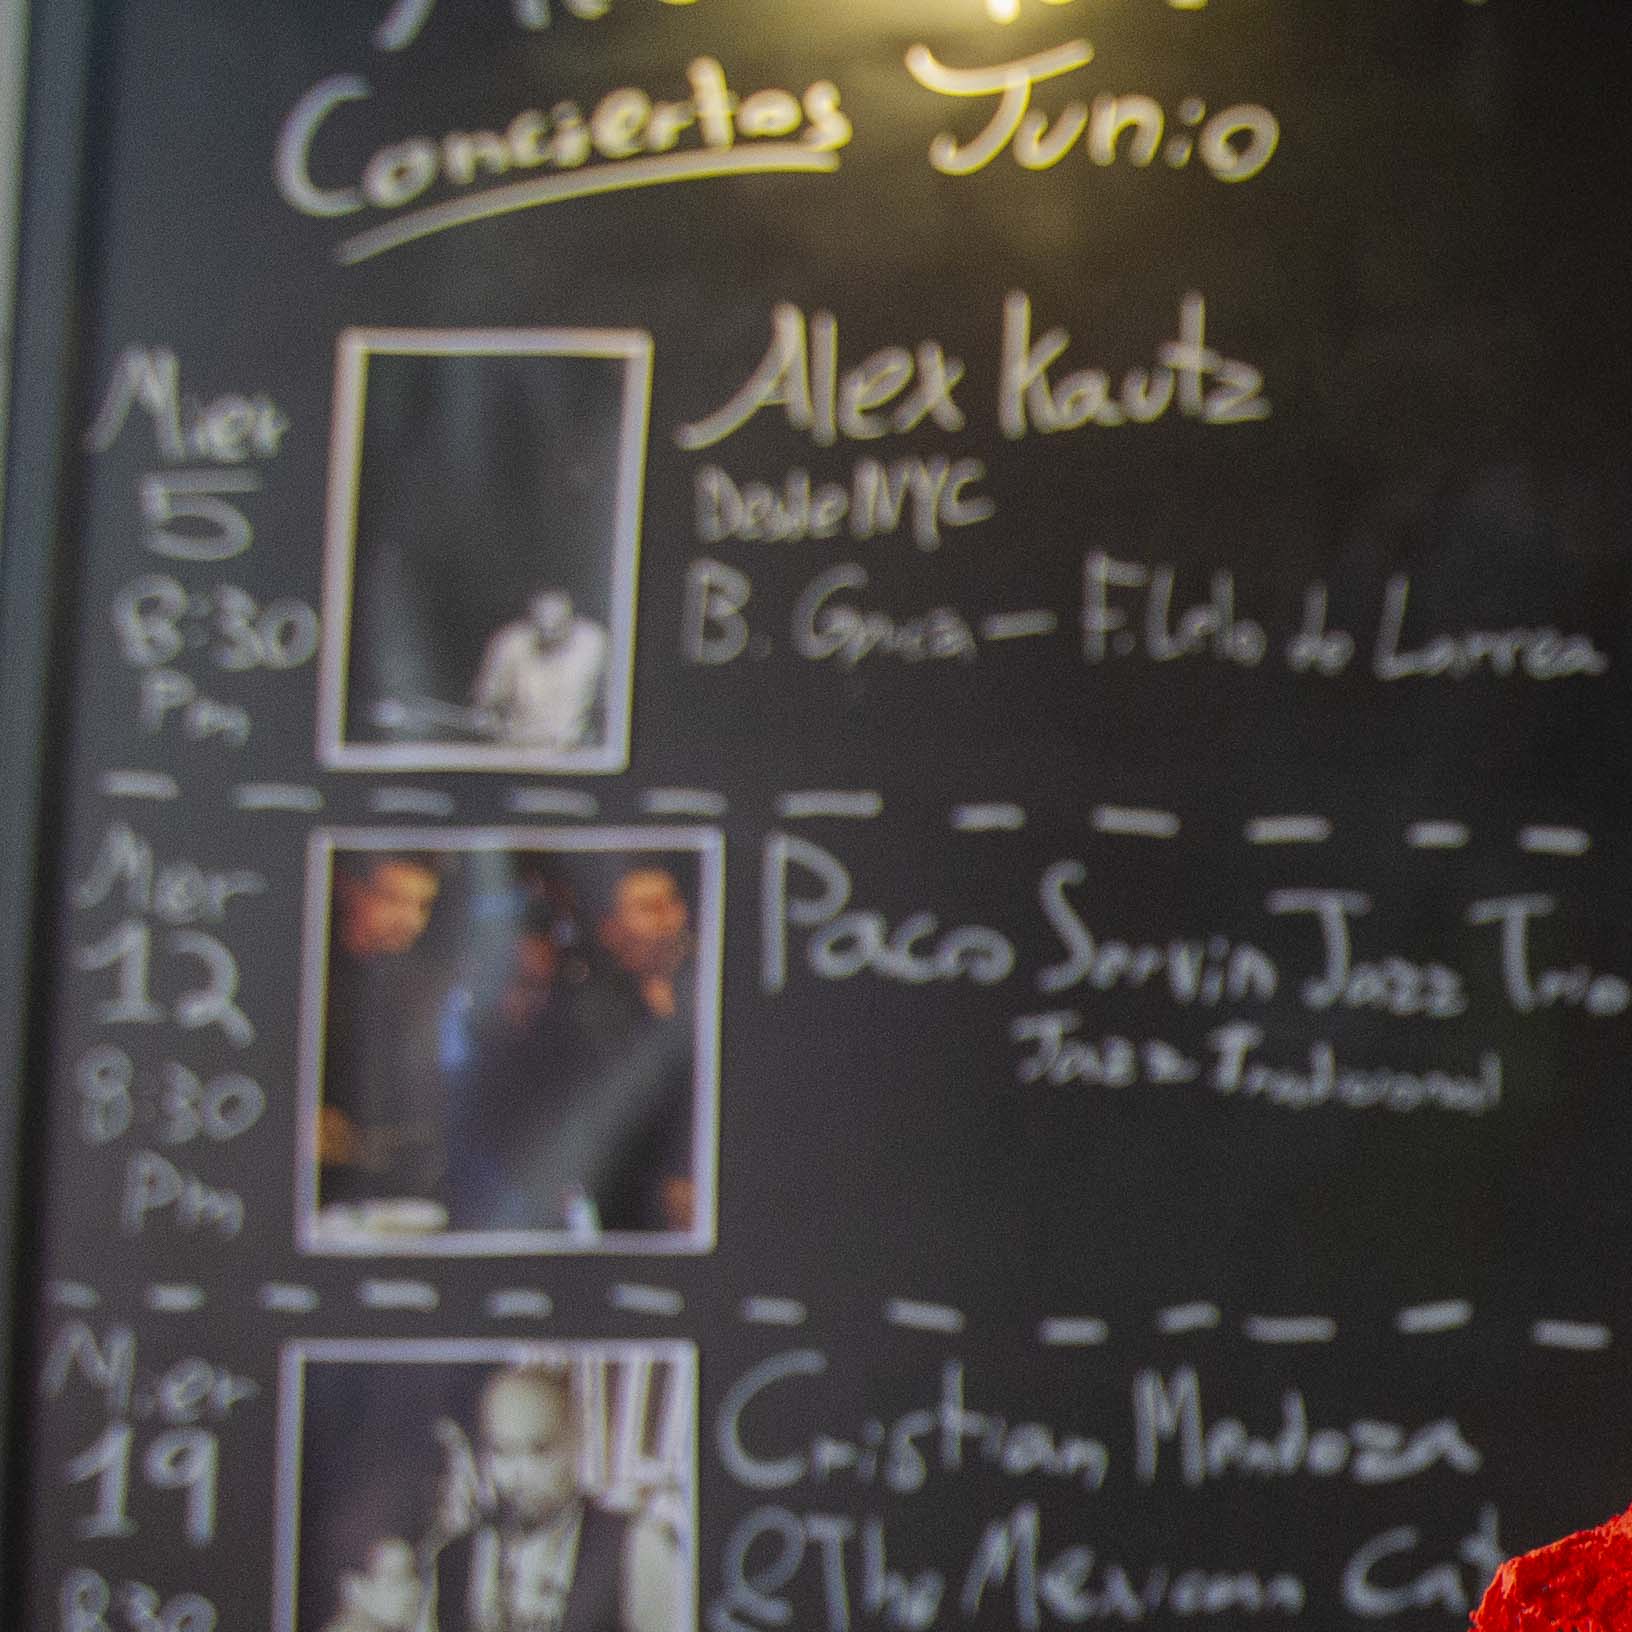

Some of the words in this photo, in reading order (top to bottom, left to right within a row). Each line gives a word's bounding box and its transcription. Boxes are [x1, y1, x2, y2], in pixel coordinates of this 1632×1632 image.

[276, 57, 852, 217] Conciertos
[906, 39, 1279, 181] Junio
[676, 300, 965, 449] Alex
[999, 289, 1270, 441] Kautz
[137, 466, 262, 561] 5
[850, 454, 996, 552] NYC
[113, 573, 320, 671] 8:30
[74, 919, 256, 1049] 12
[762, 834, 1015, 993] Paco
[1267, 888, 1466, 1016] Jazz
[716, 1346, 1110, 1493] Cristian
[1131, 1363, 1483, 1488] Mendoza
[64, 1423, 219, 1548] 19
